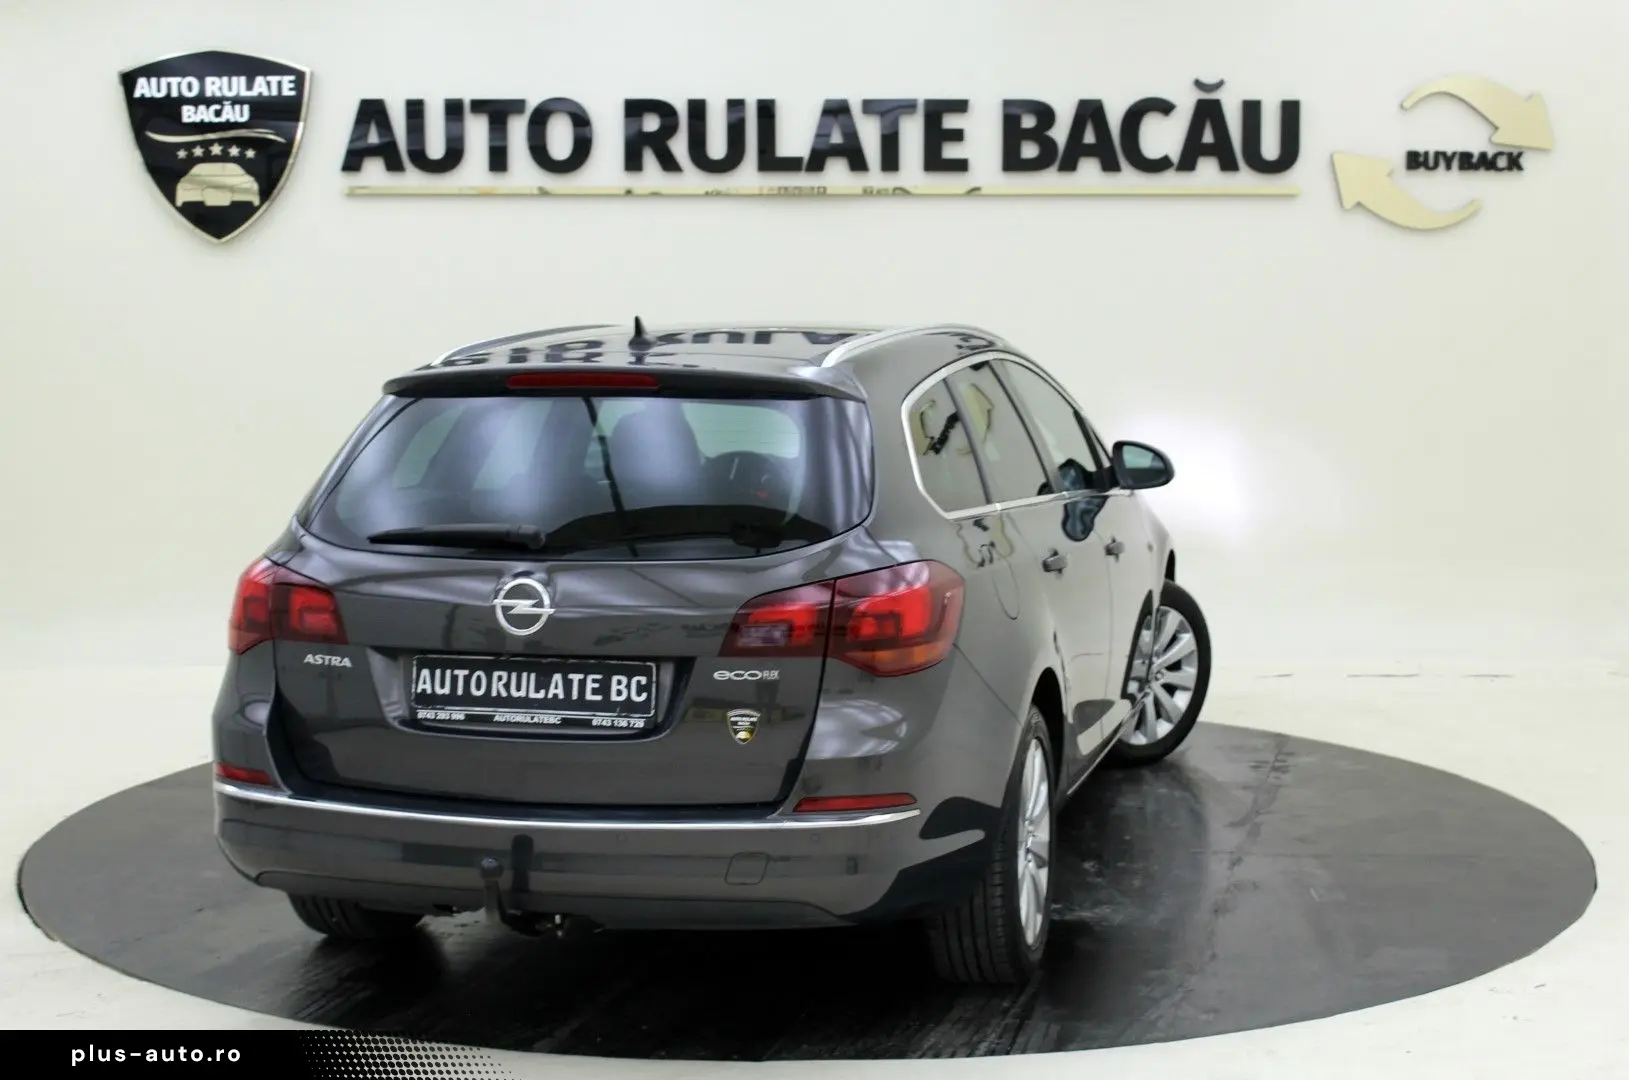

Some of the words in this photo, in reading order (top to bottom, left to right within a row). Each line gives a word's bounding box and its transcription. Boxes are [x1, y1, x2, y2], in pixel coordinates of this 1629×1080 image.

[133, 76, 200, 98] AUTO
[204, 75, 296, 97] RULATE
[181, 101, 250, 123] BACĂU
[341, 97, 594, 174] AUTO
[624, 98, 969, 173] RULATE
[1001, 78, 1301, 173] BACĂU
[1406, 150, 1524, 171] BUYBACK
[303, 654, 352, 667] ASTRA
[416, 668, 487, 697] AUTO
[491, 670, 603, 701] RULATE
[610, 674, 648, 702] BC
